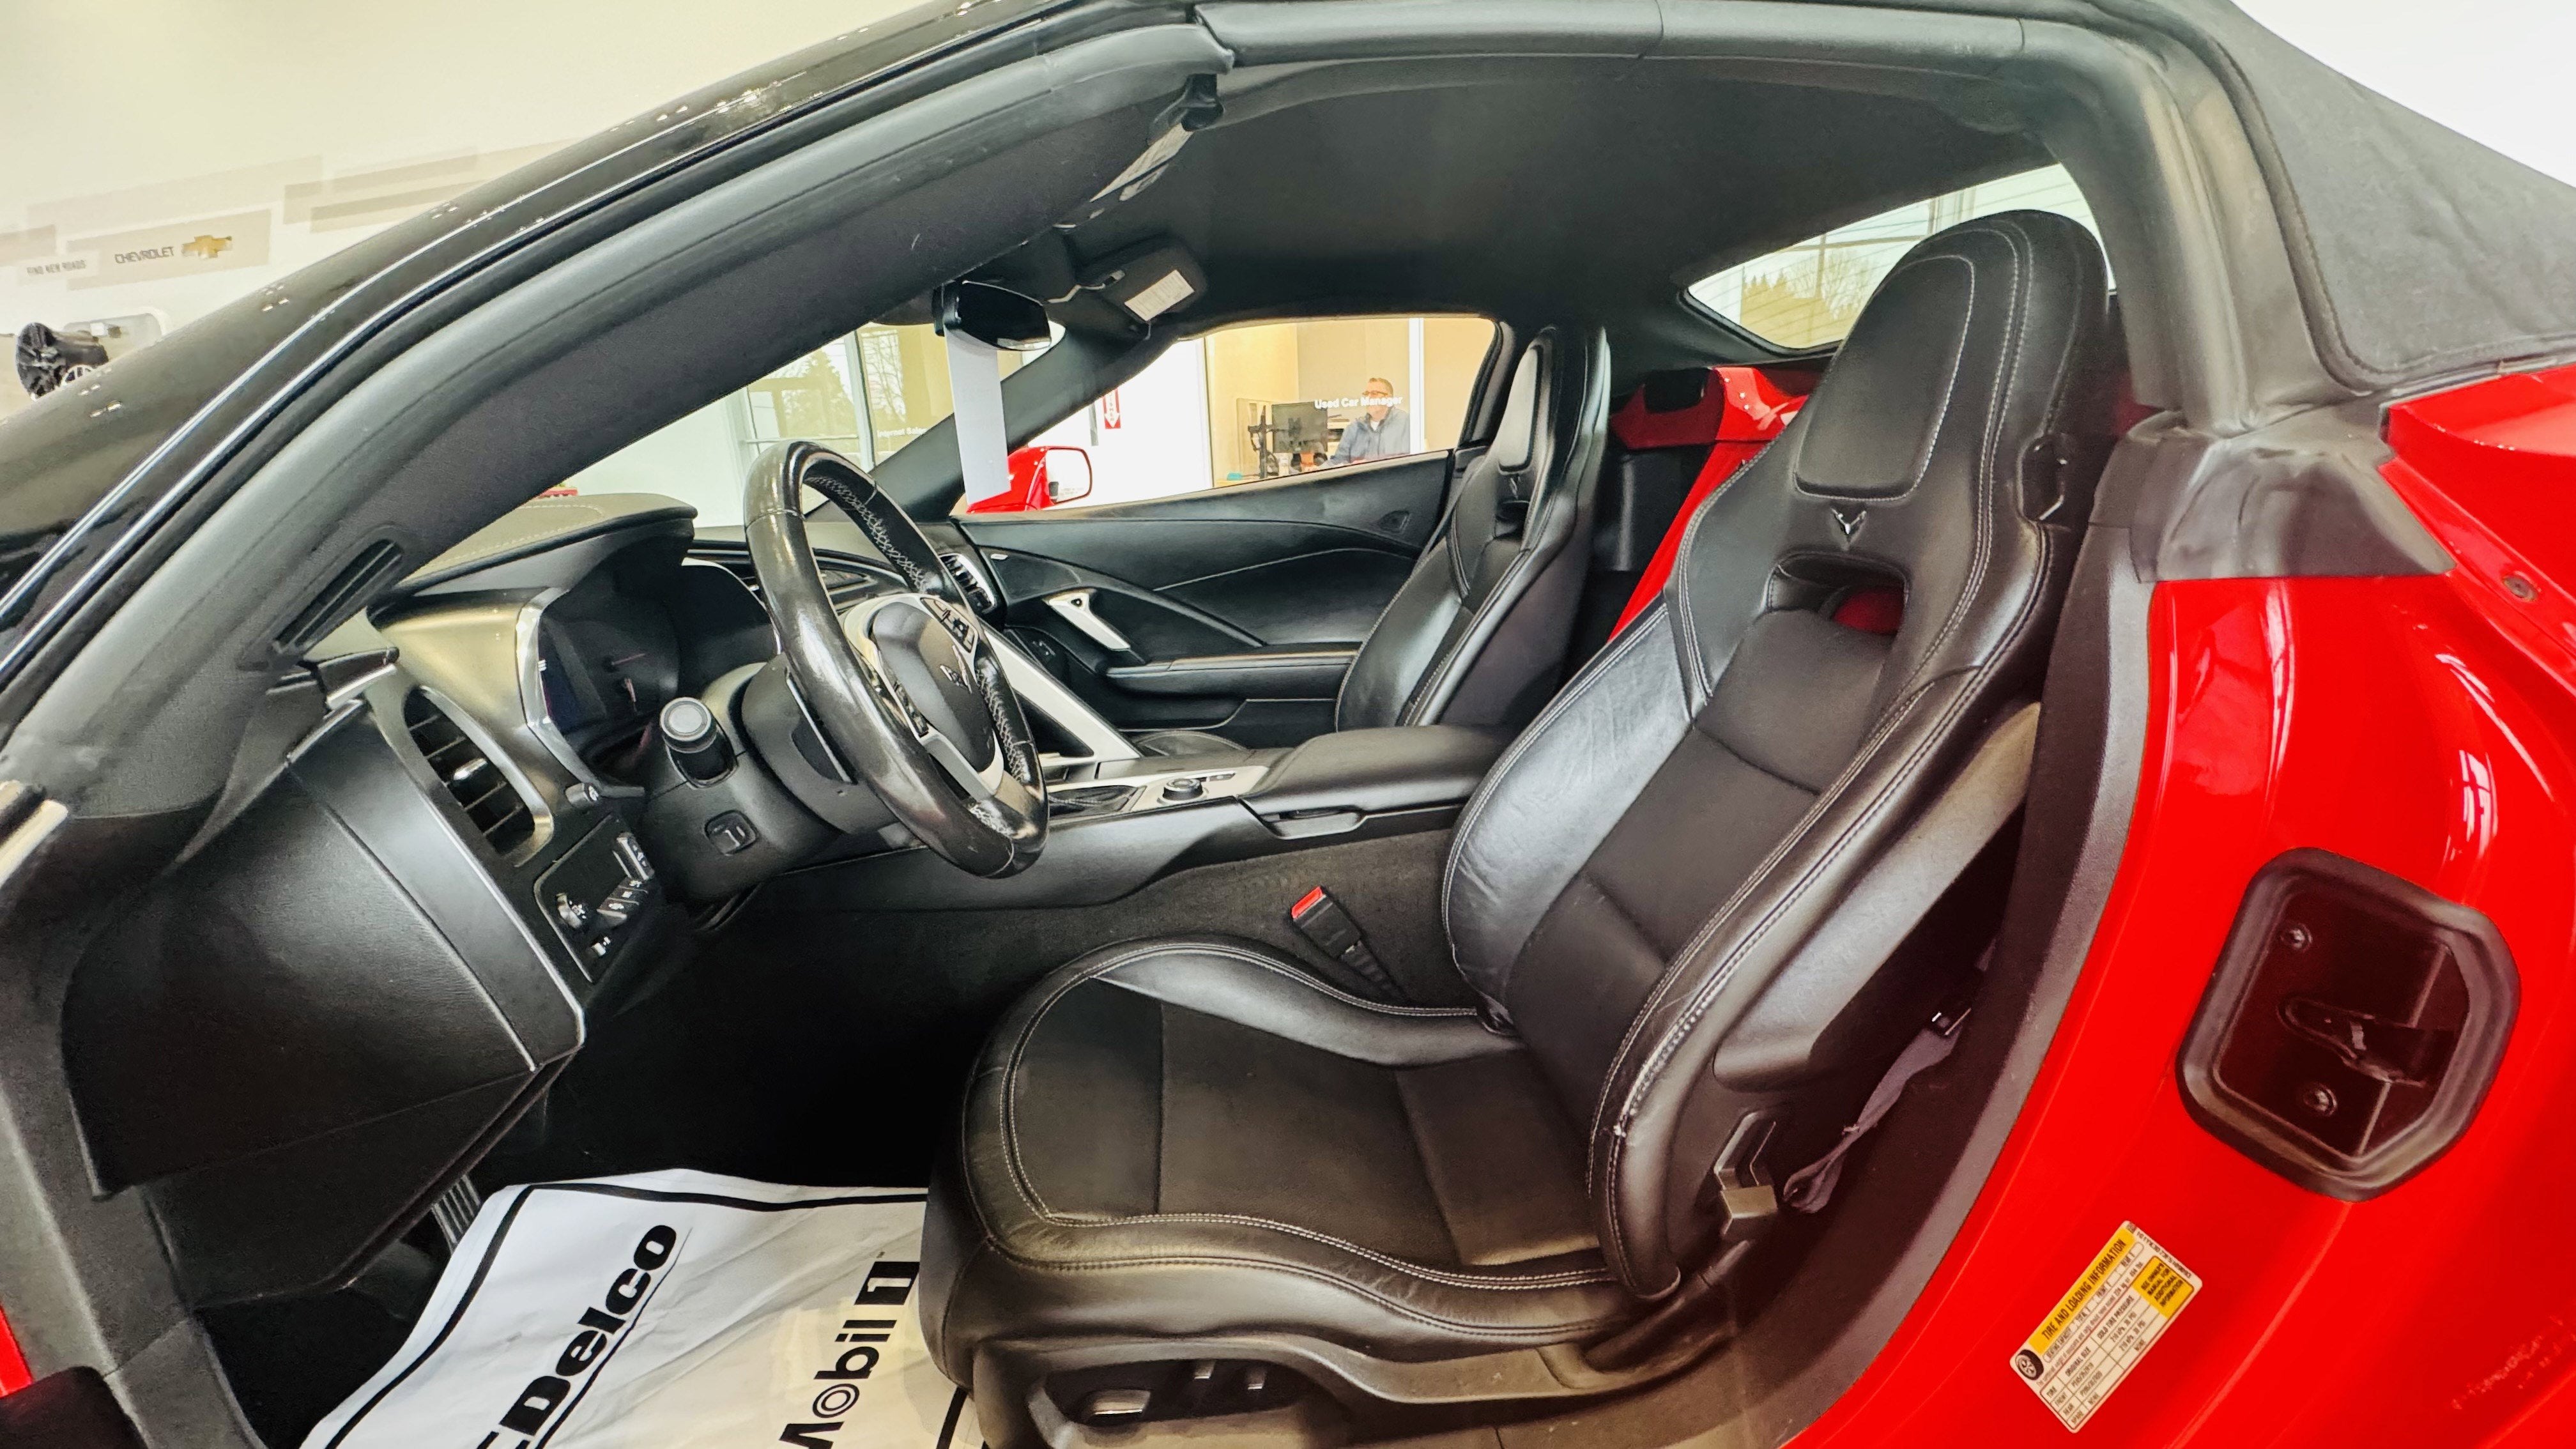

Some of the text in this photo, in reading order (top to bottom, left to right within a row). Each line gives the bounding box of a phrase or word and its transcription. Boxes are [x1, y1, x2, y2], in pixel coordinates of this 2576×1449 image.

[115, 247, 174, 264] CHEVROLET
[1314, 396, 1403, 410] Used Car Manager
[2042, 1322, 2057, 1339] TIRE
[2053, 1308, 2069, 1325] AND
[2066, 1282, 2091, 1310] LOADING
[2087, 1239, 2126, 1284] INFORMATION
[2114, 1295, 2133, 1318] PRESSURE
[477, 1225, 677, 1449] Delco
[2046, 1386, 2057, 1397] TIRE
